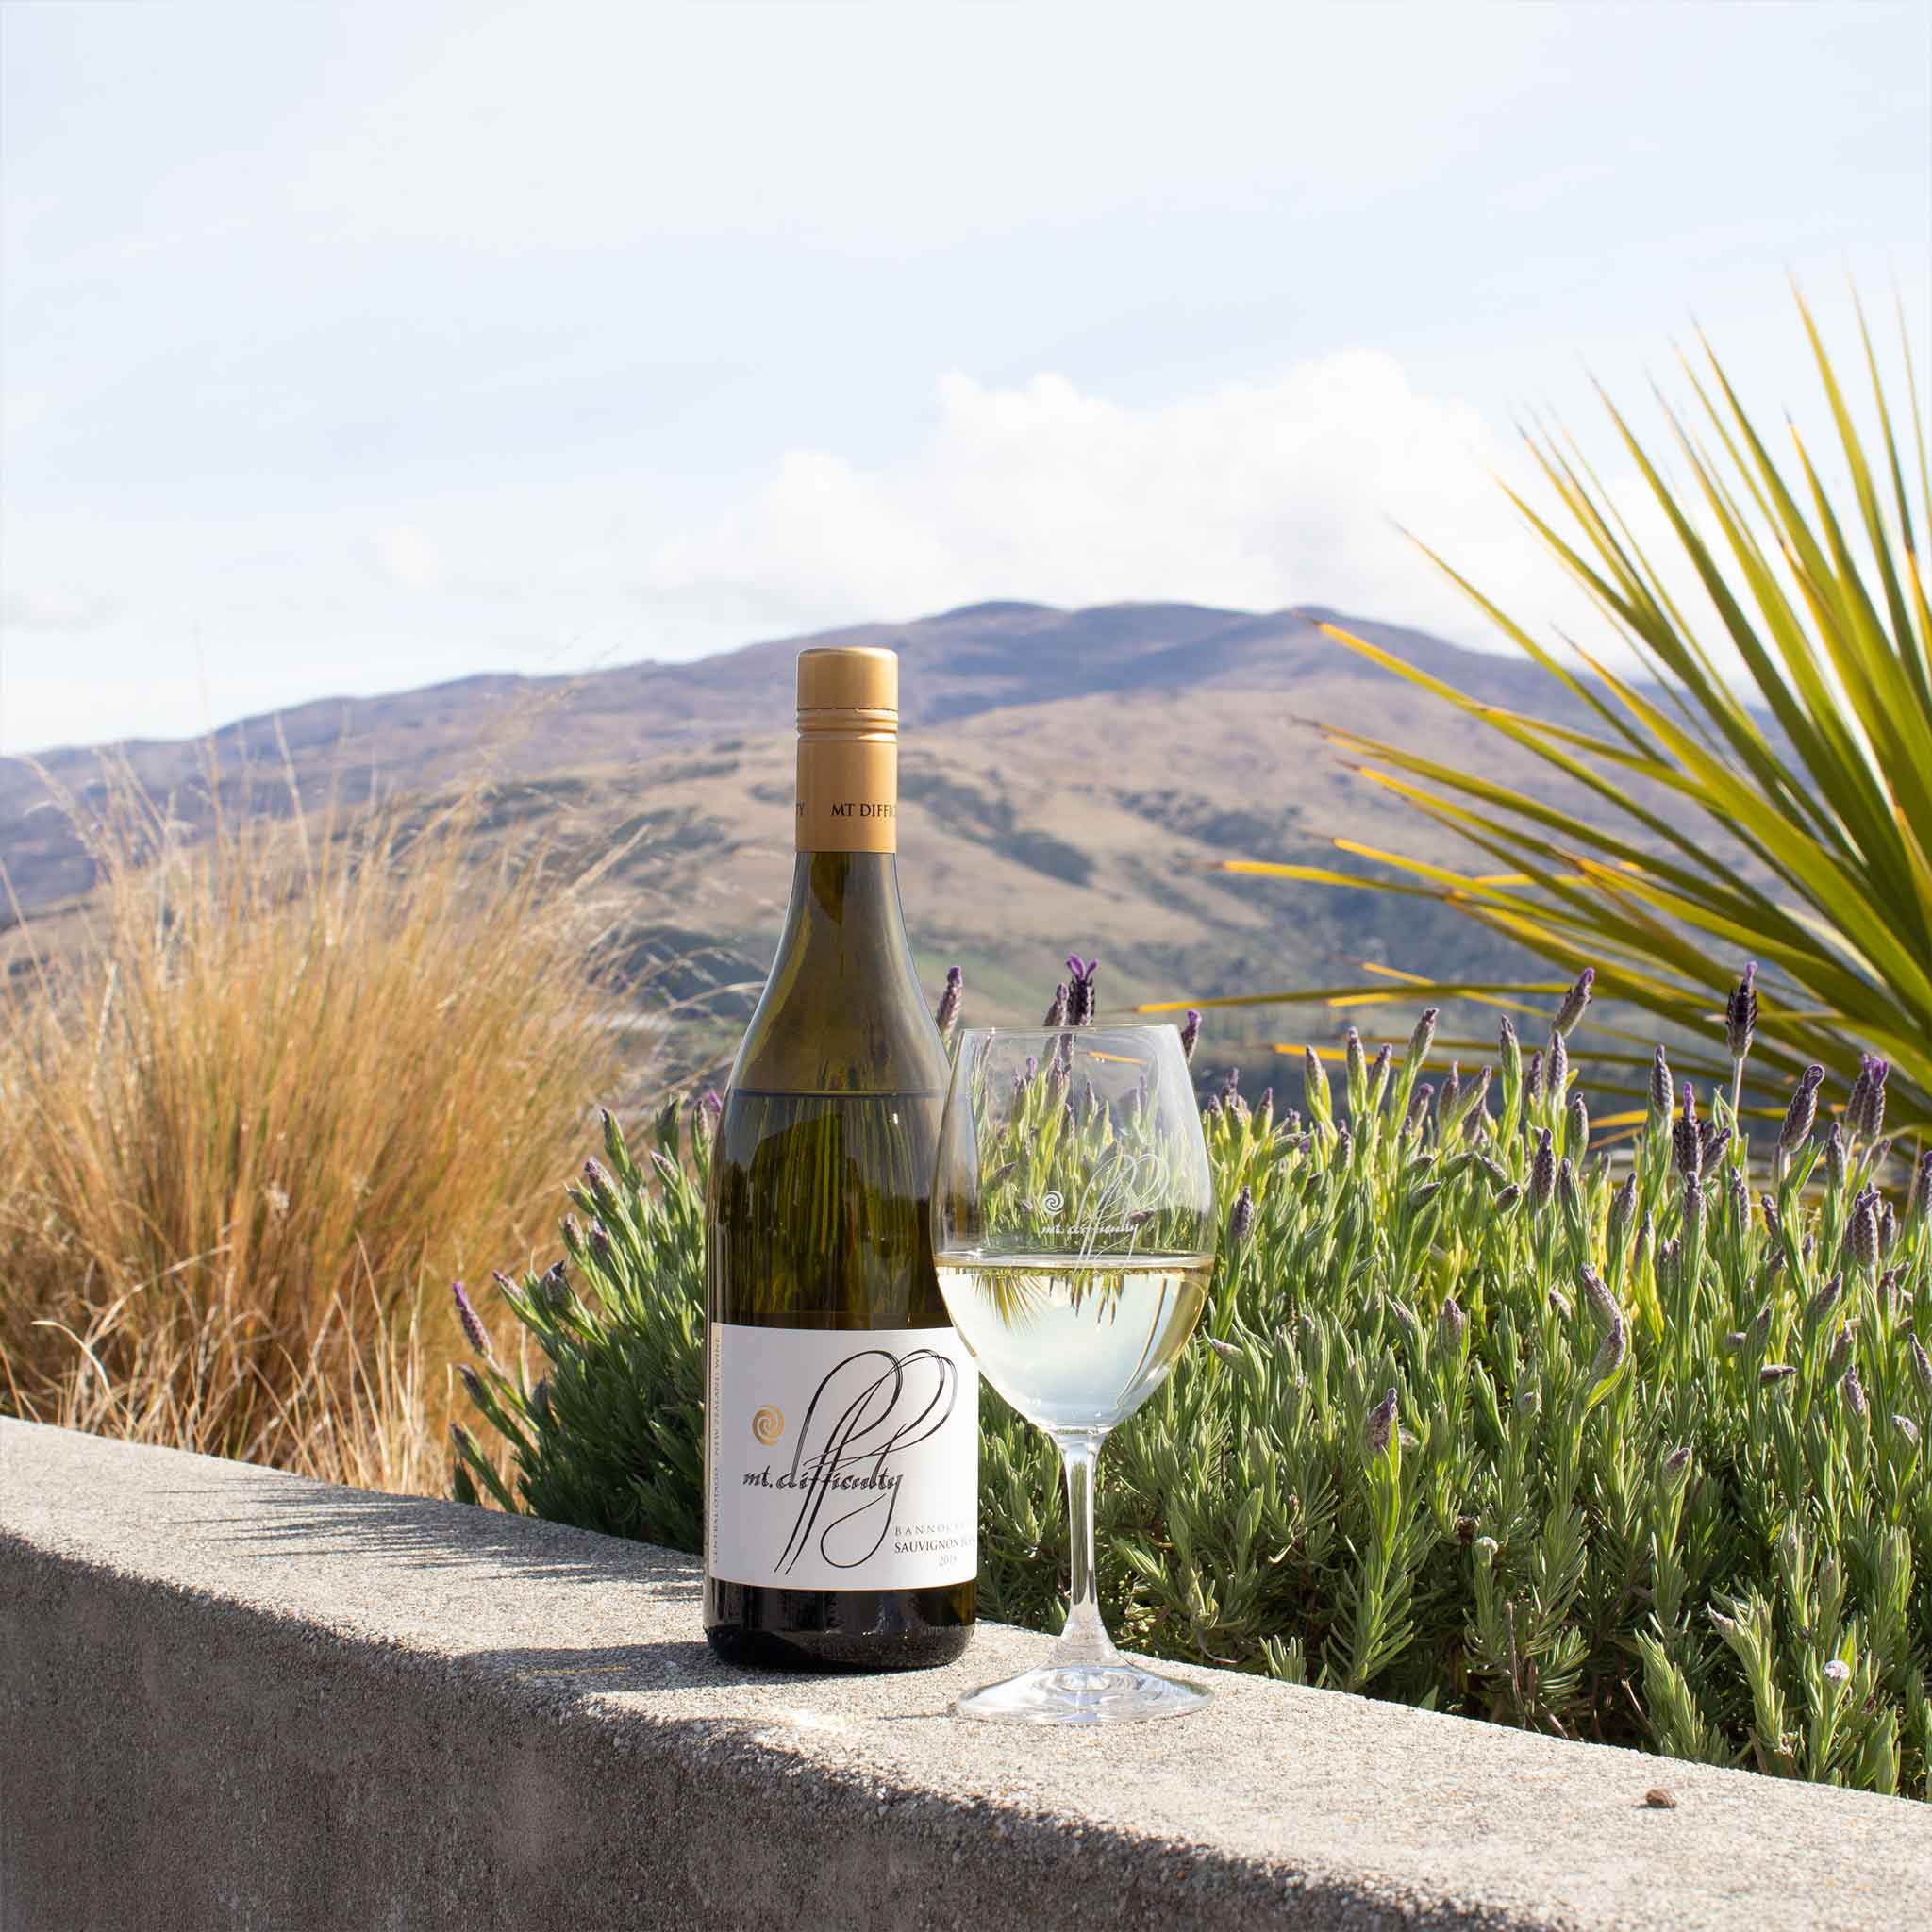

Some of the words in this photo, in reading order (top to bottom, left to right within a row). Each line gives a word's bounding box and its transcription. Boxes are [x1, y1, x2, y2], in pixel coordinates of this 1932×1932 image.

[830, 803, 855, 817] MT
[742, 1465, 774, 1488] mt.
[894, 1539, 958, 1554] SAUVIGNON
